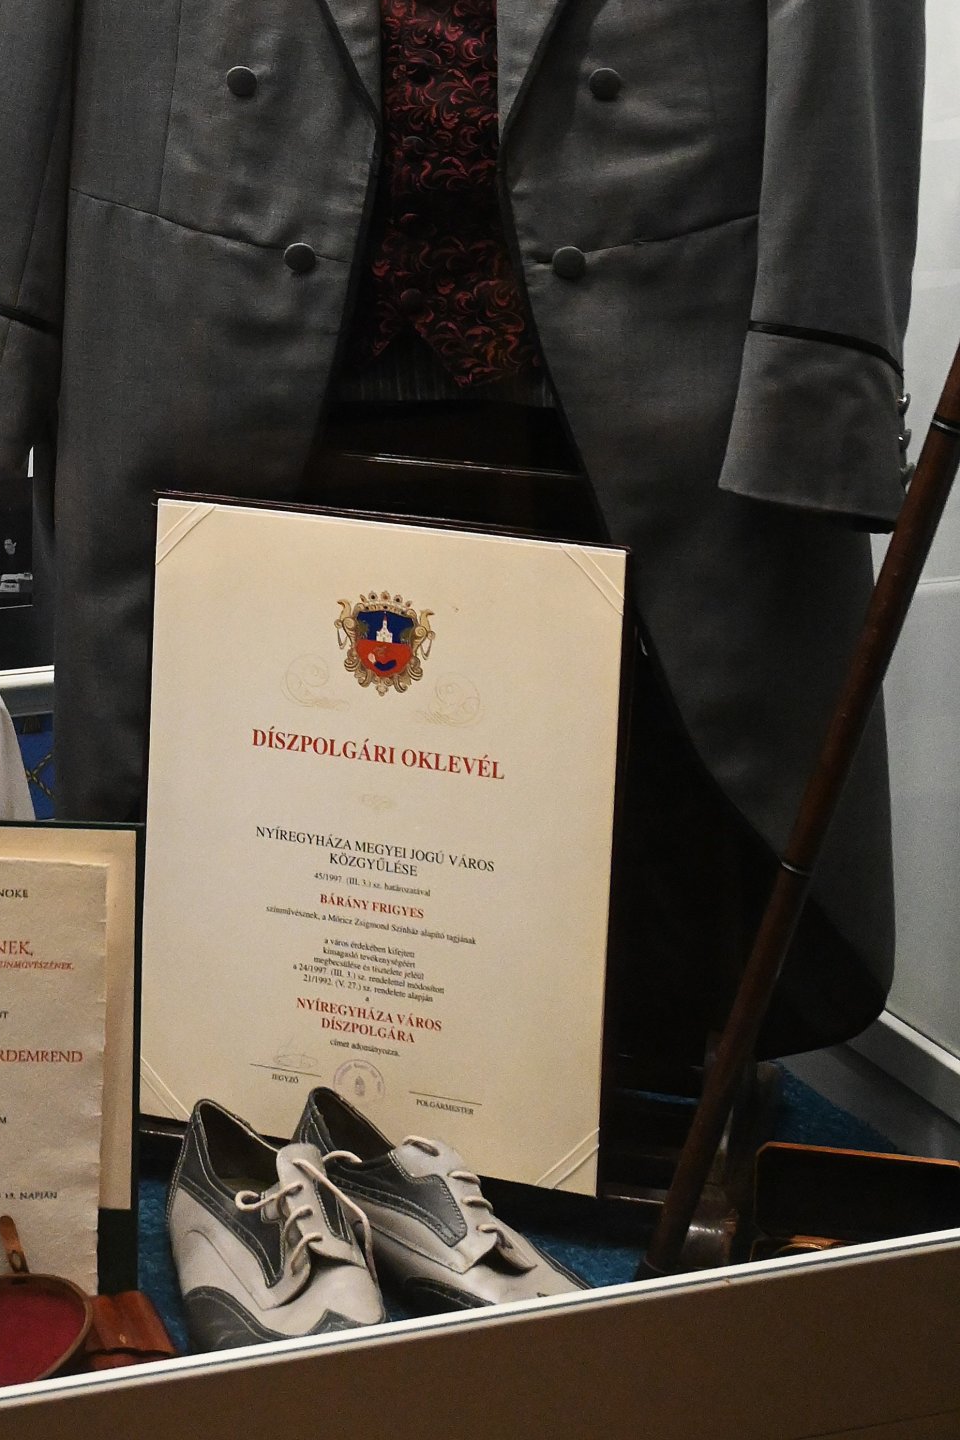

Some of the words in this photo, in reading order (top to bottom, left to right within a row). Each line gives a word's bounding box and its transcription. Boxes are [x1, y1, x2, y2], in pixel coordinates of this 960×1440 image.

[251, 727, 396, 765] DÍSZPOLGÁRI
[401, 748, 505, 780] OKLEVÉL
[256, 825, 351, 851] NYÍREGYHÁZA
[355, 841, 406, 859] MEGYEI
[410, 849, 445, 864] JOGÚ
[449, 854, 495, 872] VÁROS
[329, 852, 418, 877] KÖZGYŰLÉSE
[320, 892, 369, 911] BÁRÁNY
[372, 901, 424, 919] FRIGYES
[355, 917, 390, 932] Zsigmond
[330, 937, 349, 948] város
[296, 997, 393, 1024] NYÍREGYHÁZA
[397, 1013, 442, 1032] VÁROS
[321, 1016, 416, 1043] DÍSZPOLGÁRA
